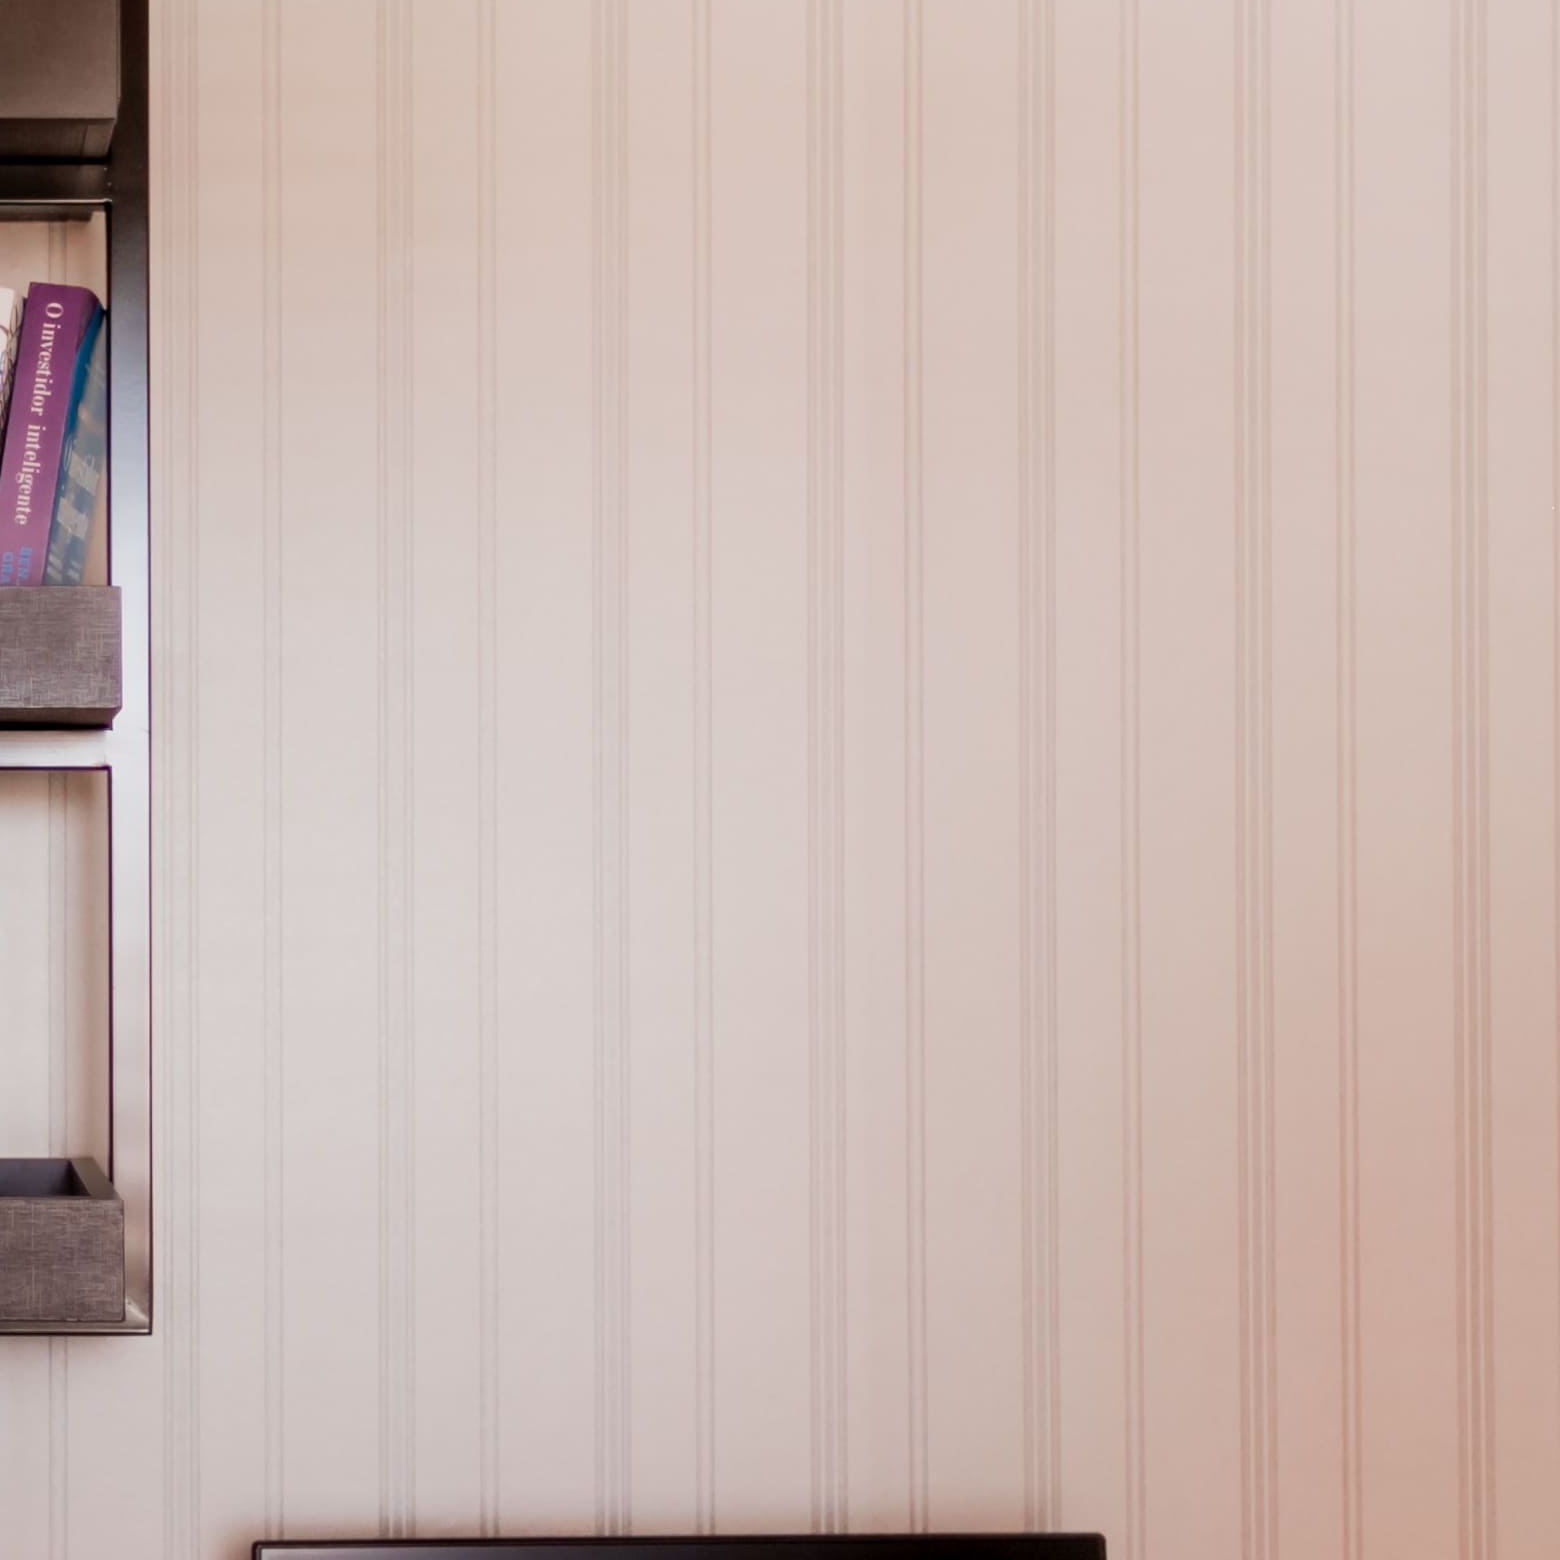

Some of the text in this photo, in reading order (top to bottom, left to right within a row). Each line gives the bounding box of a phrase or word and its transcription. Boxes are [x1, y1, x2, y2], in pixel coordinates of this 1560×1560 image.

[15, 302, 64, 525] O investidor inteligente
[17, 546, 33, 586] BEN
